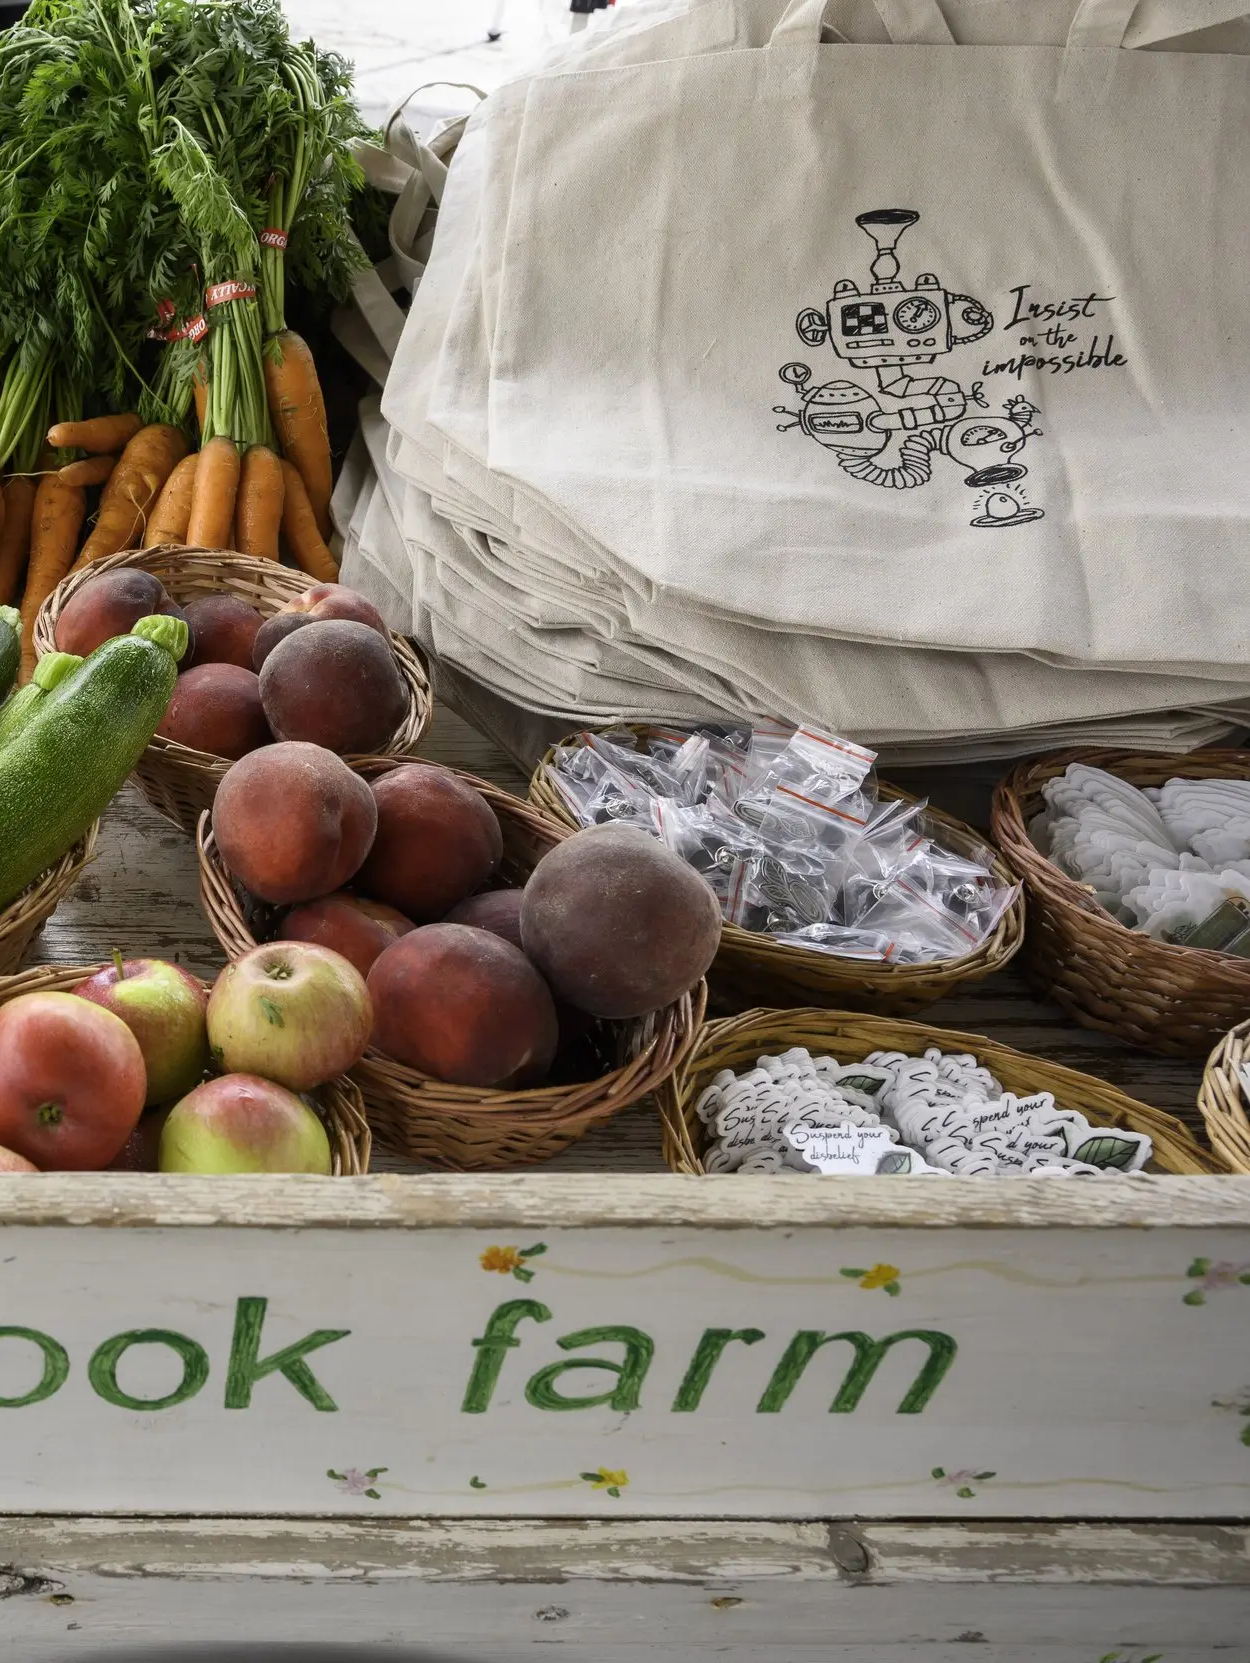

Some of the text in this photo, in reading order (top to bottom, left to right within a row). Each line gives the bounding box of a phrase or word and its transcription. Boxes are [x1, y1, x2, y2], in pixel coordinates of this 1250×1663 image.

[1003, 284, 1116, 331] Insist
[1020, 323, 1077, 348] on the
[982, 335, 1128, 381] impossible
[1016, 1098, 1048, 1117] your
[790, 1124, 852, 1147] Suspend
[857, 1131, 884, 1148] your
[810, 1144, 863, 1166] disbelief
[460, 1298, 957, 1415] farm
